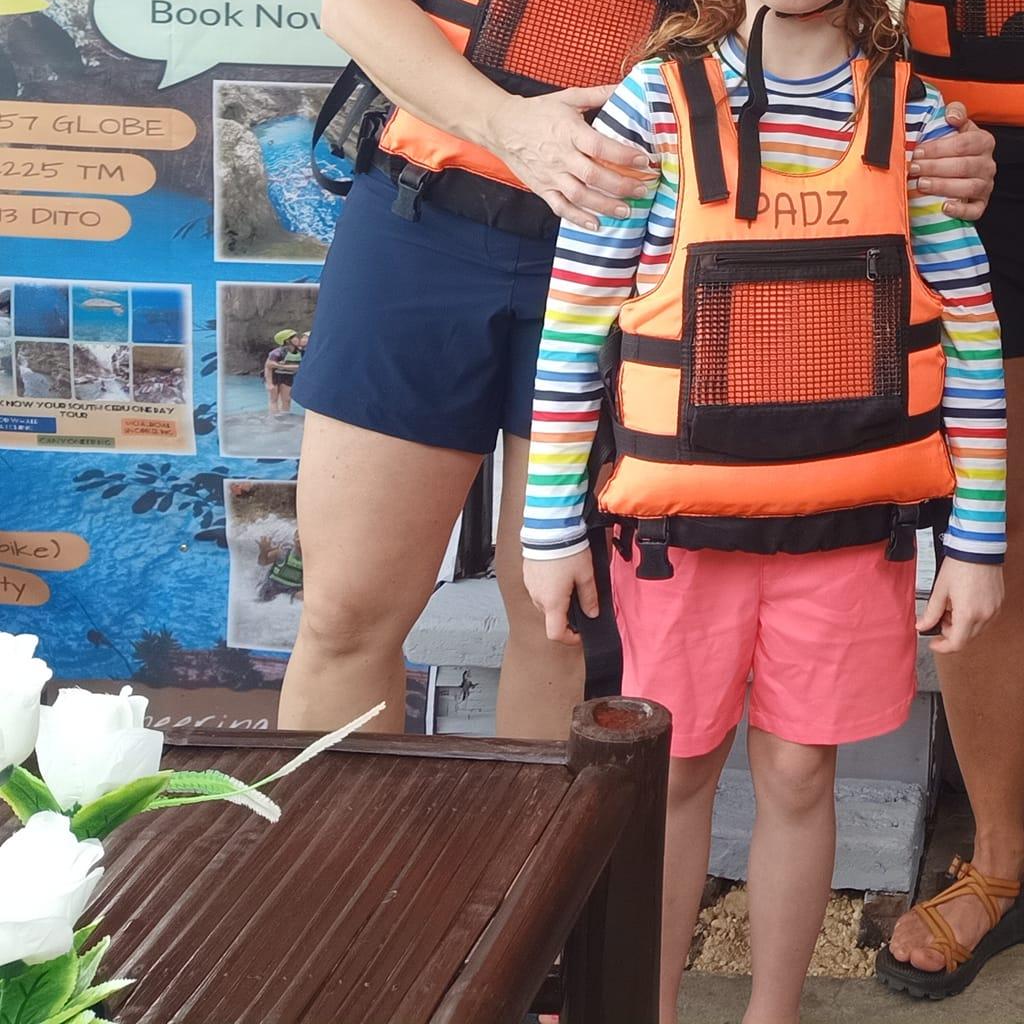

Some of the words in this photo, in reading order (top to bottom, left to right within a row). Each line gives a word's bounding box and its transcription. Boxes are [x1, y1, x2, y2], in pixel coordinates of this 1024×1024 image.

[151, 0, 244, 28] Book
[52, 114, 165, 137] GLOBE
[77, 163, 125, 182] TM
[31, 207, 101, 228] DITO
[746, 190, 850, 230] PADZ
[37, 401, 66, 410] YOUR
[68, 402, 103, 412] SOUTH
[60, 411, 88, 419] TOUR
